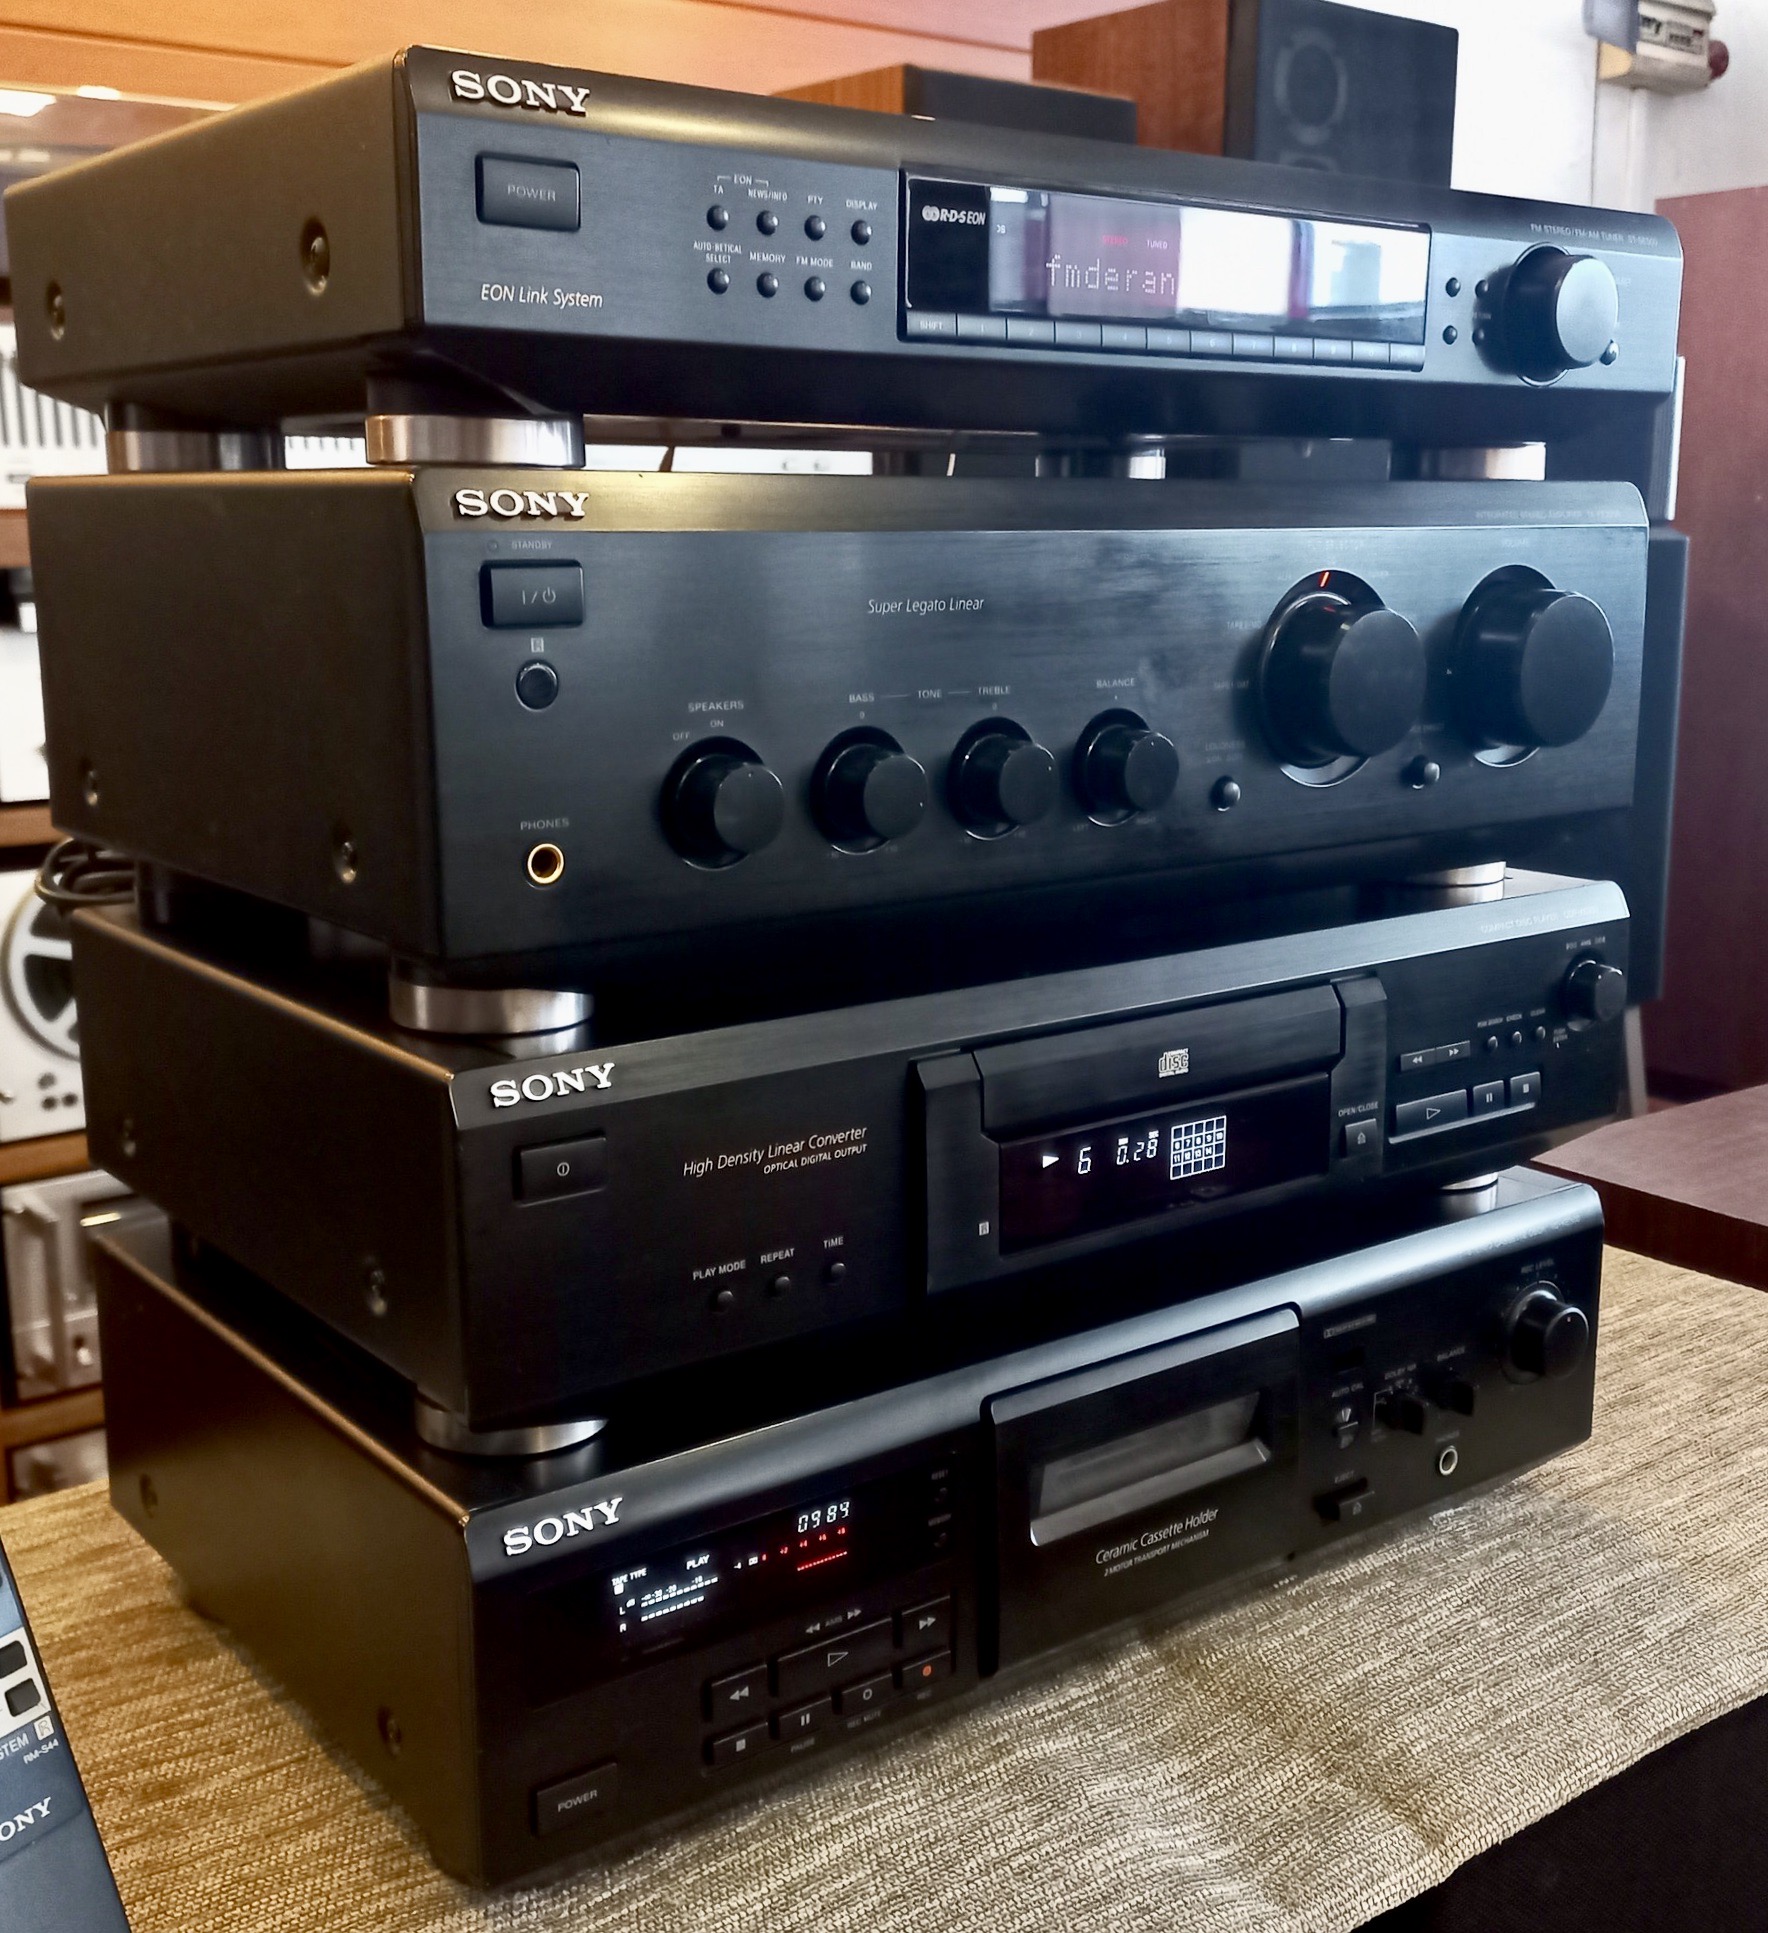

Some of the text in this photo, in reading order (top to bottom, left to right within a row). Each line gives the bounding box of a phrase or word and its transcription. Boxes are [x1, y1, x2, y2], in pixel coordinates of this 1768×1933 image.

[451, 69, 591, 114] SONY
[713, 184, 725, 195] TA
[734, 174, 753, 187] EON
[507, 184, 556, 203] POWER
[807, 195, 823, 206] PTY
[845, 199, 878, 212] DISPLAY
[705, 253, 732, 264] SELECT
[750, 252, 786, 264] MEMORY
[796, 256, 834, 269] FM MODE
[850, 261, 873, 272] BAND
[1046, 253, 1175, 296] fmderan
[481, 283, 604, 310] EON Link System
[919, 320, 944, 332] SHIFT
[455, 489, 590, 517] SONY
[511, 540, 552, 550] STANDBY
[868, 596, 984, 617] Super Legato Linear
[1096, 677, 1136, 689] BALANCE
[849, 685, 1011, 704] BASS TONE TREBLE
[688, 700, 745, 713] SPEAKERS
[710, 719, 724, 728] ON
[672, 731, 690, 741] OFF
[520, 817, 570, 831] PHONES
[1158, 1051, 1190, 1074] disc
[490, 1062, 615, 1108] SONY
[1338, 1101, 1379, 1118] OPEN/CLOSE
[683, 1127, 868, 1178] High Density Linear Converter
[763, 1143, 868, 1174] OPTICAL DIGITAL OUTPUT
[1077, 1146, 1092, 1174] 6
[823, 1235, 844, 1250] TIME
[760, 1247, 795, 1265] REPEAT
[692, 1259, 746, 1282] PLAY MODE
[797, 1501, 850, 1533] 0984
[503, 1497, 623, 1556] SONY
[1095, 1507, 1219, 1565] Ceramic Cassette Holder
[1109, 1558, 1134, 1575] MOTOR
[1134, 1544, 1171, 1565] TRANSPORT
[1170, 1528, 1210, 1551] MECHANISM
[686, 1553, 711, 1571] PLAY
[611, 1567, 648, 1587] TAPE TYPE
[618, 1606, 626, 1616] L
[23, 1738, 60, 1766] RM-S44
[557, 1788, 598, 1813] POWER
